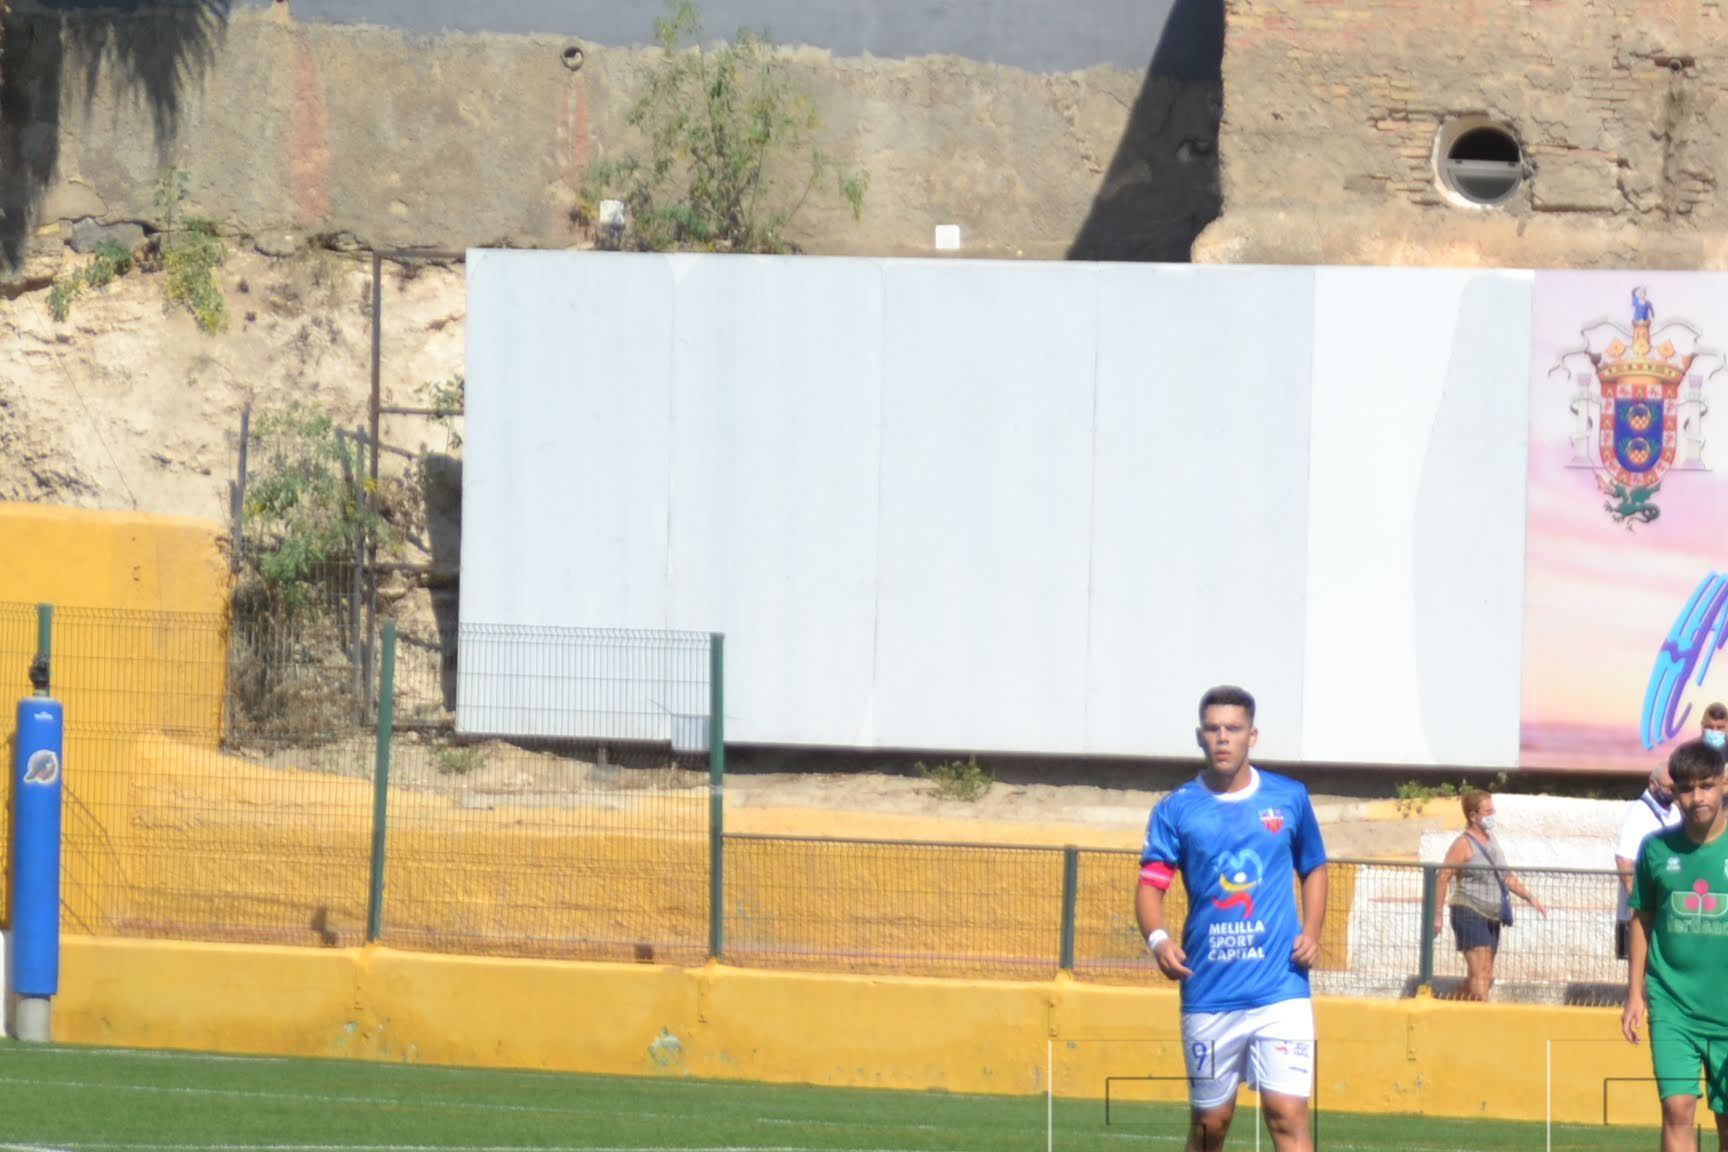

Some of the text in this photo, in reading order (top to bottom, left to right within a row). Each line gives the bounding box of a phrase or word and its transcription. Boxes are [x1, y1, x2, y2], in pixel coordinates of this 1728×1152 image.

[1208, 919, 1266, 936] MELILLA
[1208, 934, 1256, 949] SPORT
[1207, 946, 1266, 961] CAPITAL
[1192, 1041, 1208, 1072] 9
